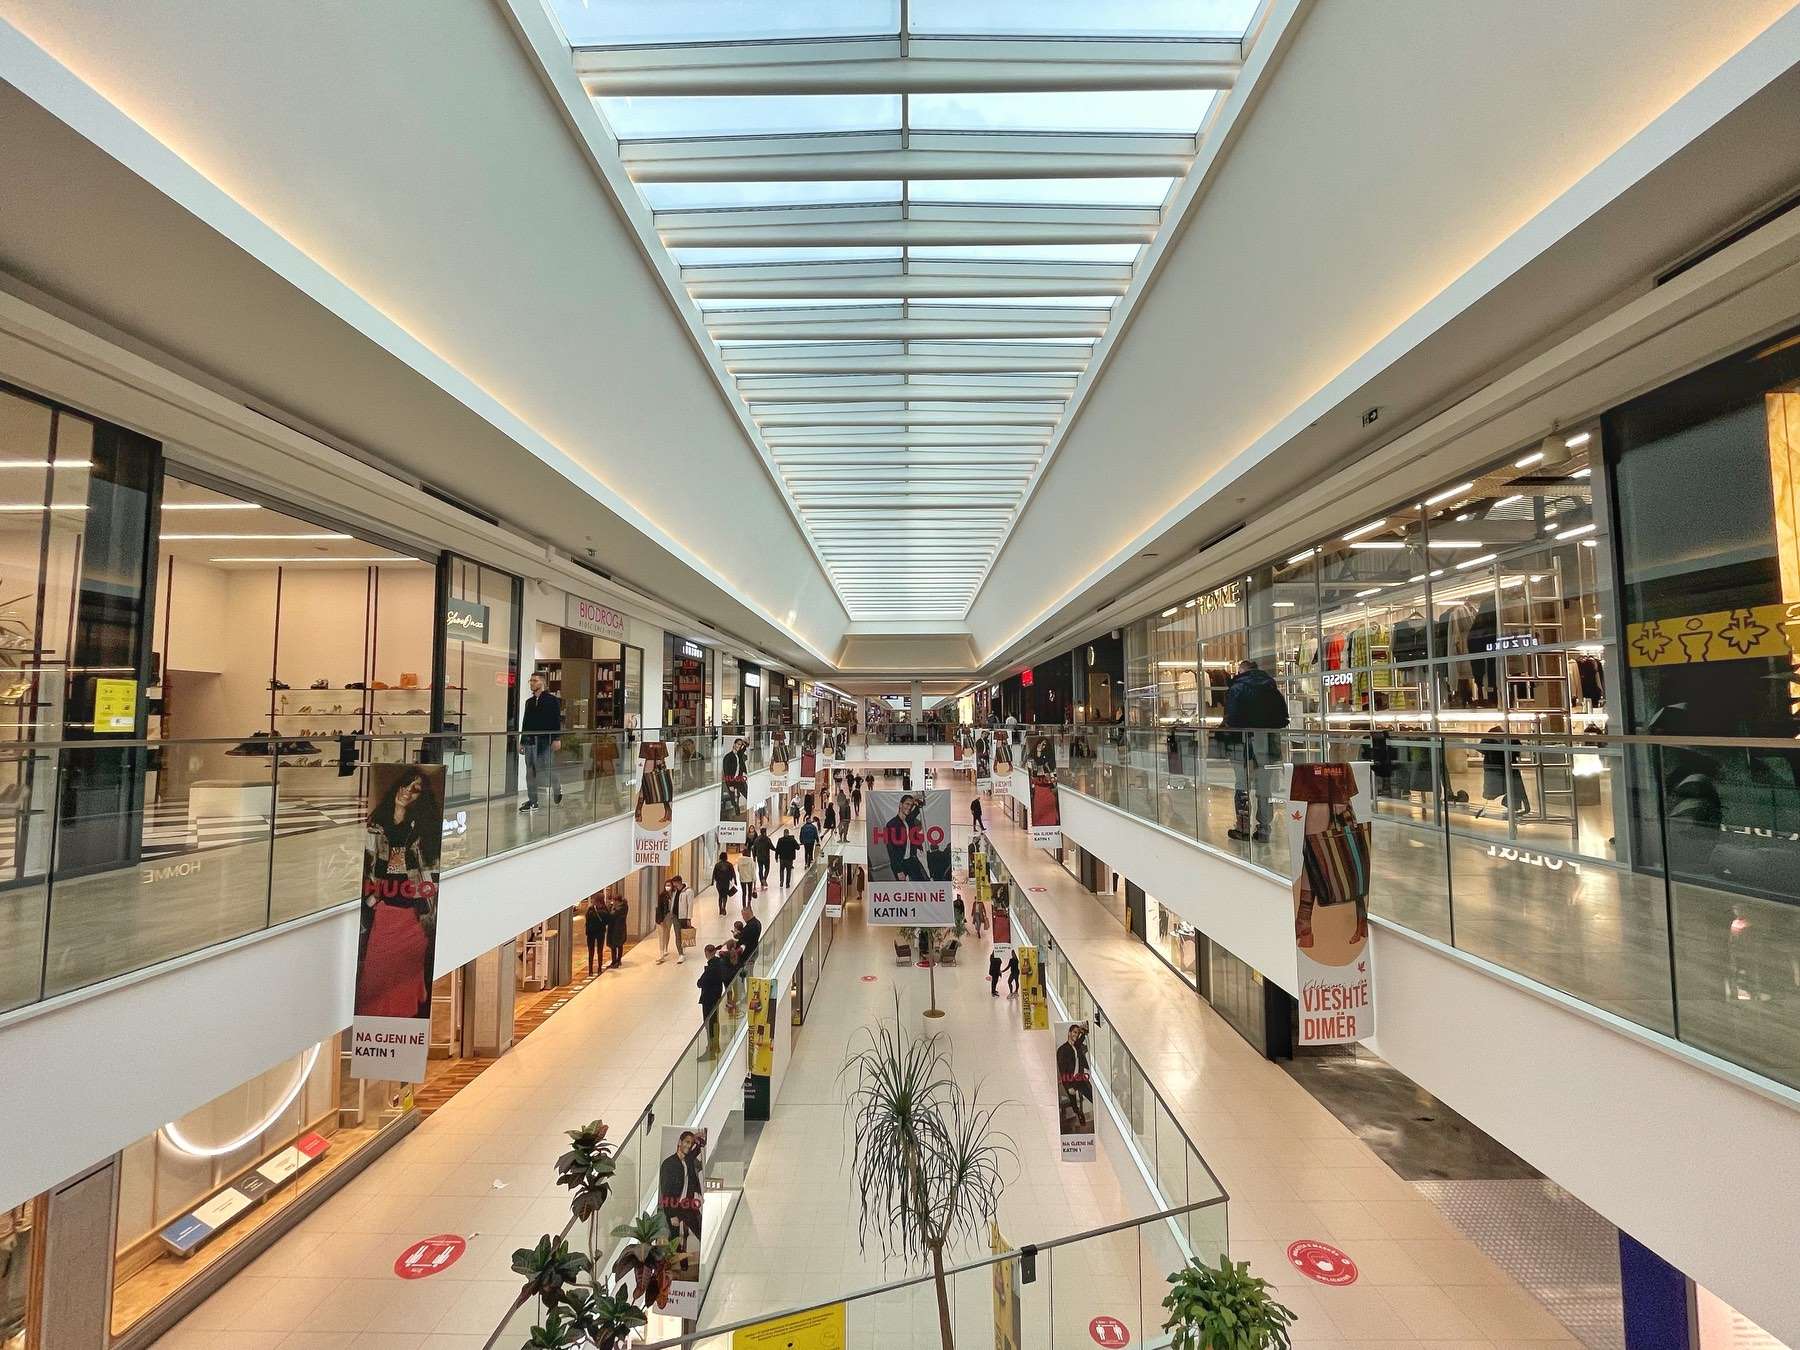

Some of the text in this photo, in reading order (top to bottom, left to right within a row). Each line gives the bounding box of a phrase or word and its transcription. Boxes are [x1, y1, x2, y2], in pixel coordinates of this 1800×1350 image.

[579, 601, 624, 631] BIODROGA
[873, 825, 945, 846] HUGO
[635, 837, 669, 851] VJESHTË
[635, 850, 660, 864] DIMËR
[365, 879, 436, 898] HUGO
[873, 889, 946, 903] NA GJENI NË
[873, 907, 916, 918] KATIN 1
[1303, 979, 1368, 1012] VJESHTË
[1305, 1011, 1356, 1040] DIMËR
[356, 1032, 425, 1045] NA GJENI NË
[355, 1047, 395, 1058] KATIN 1
[660, 1194, 705, 1211] HUGO
